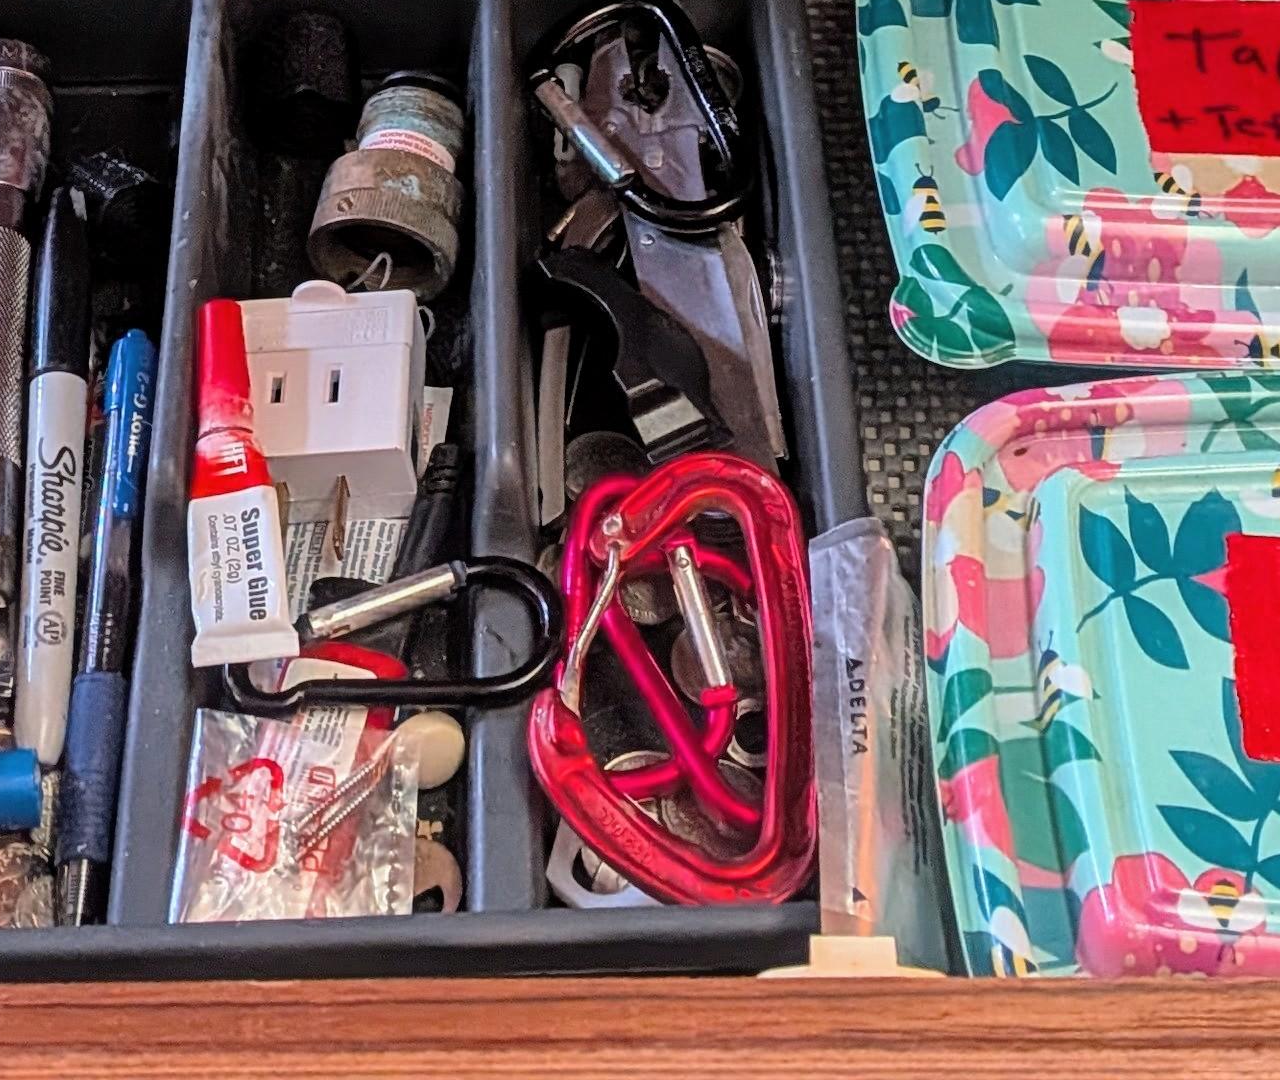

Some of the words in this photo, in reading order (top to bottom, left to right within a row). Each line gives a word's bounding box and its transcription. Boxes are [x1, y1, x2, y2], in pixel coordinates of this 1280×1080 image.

[133, 371, 150, 408] G-2
[128, 411, 143, 456] PILOT
[214, 441, 248, 476] HFT
[31, 437, 77, 557] Sharpie
[208, 515, 220, 550] Contains
[240, 507, 264, 571] Super
[39, 570, 52, 606] POINT
[53, 570, 66, 596] FINE
[225, 558, 242, 584] (2g)
[247, 576, 269, 622] Glue
[849, 678, 868, 755] DELTA
